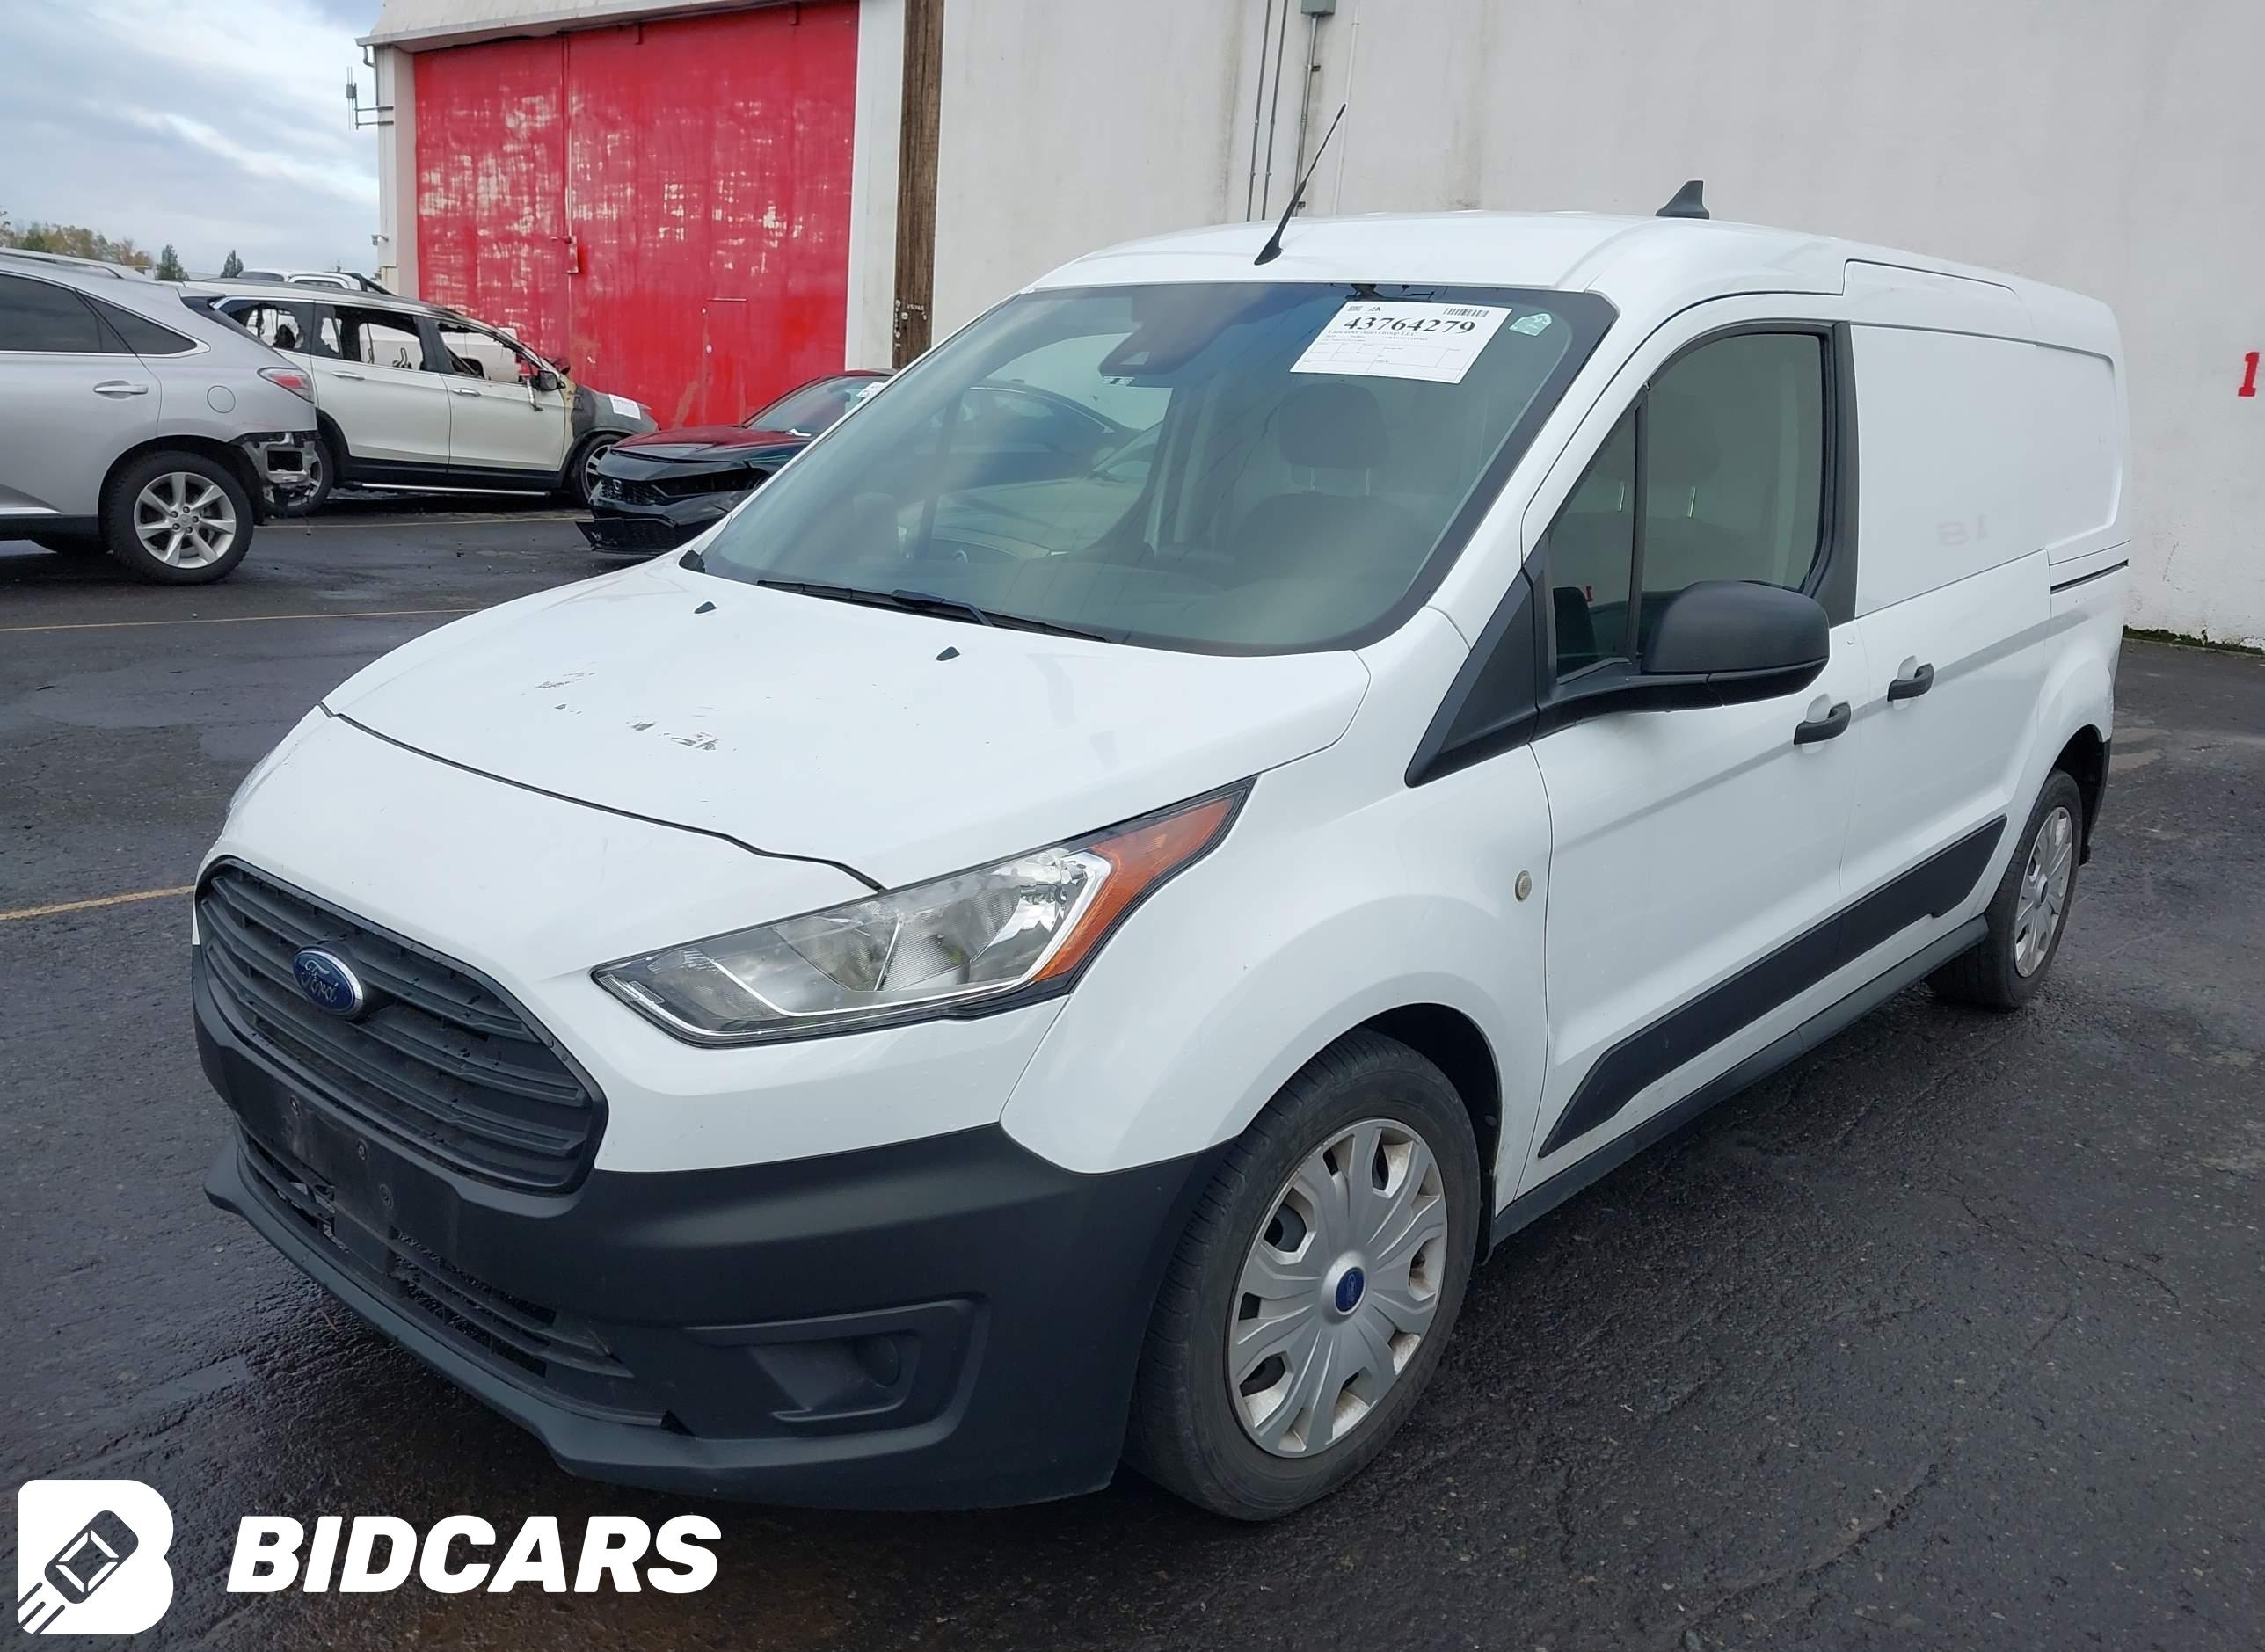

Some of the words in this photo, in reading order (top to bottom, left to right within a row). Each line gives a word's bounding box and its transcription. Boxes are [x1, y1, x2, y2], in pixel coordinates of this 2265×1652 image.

[1343, 316, 1476, 334] 43764279
[2238, 352, 2260, 397] 1
[302, 959, 339, 1002] Ford
